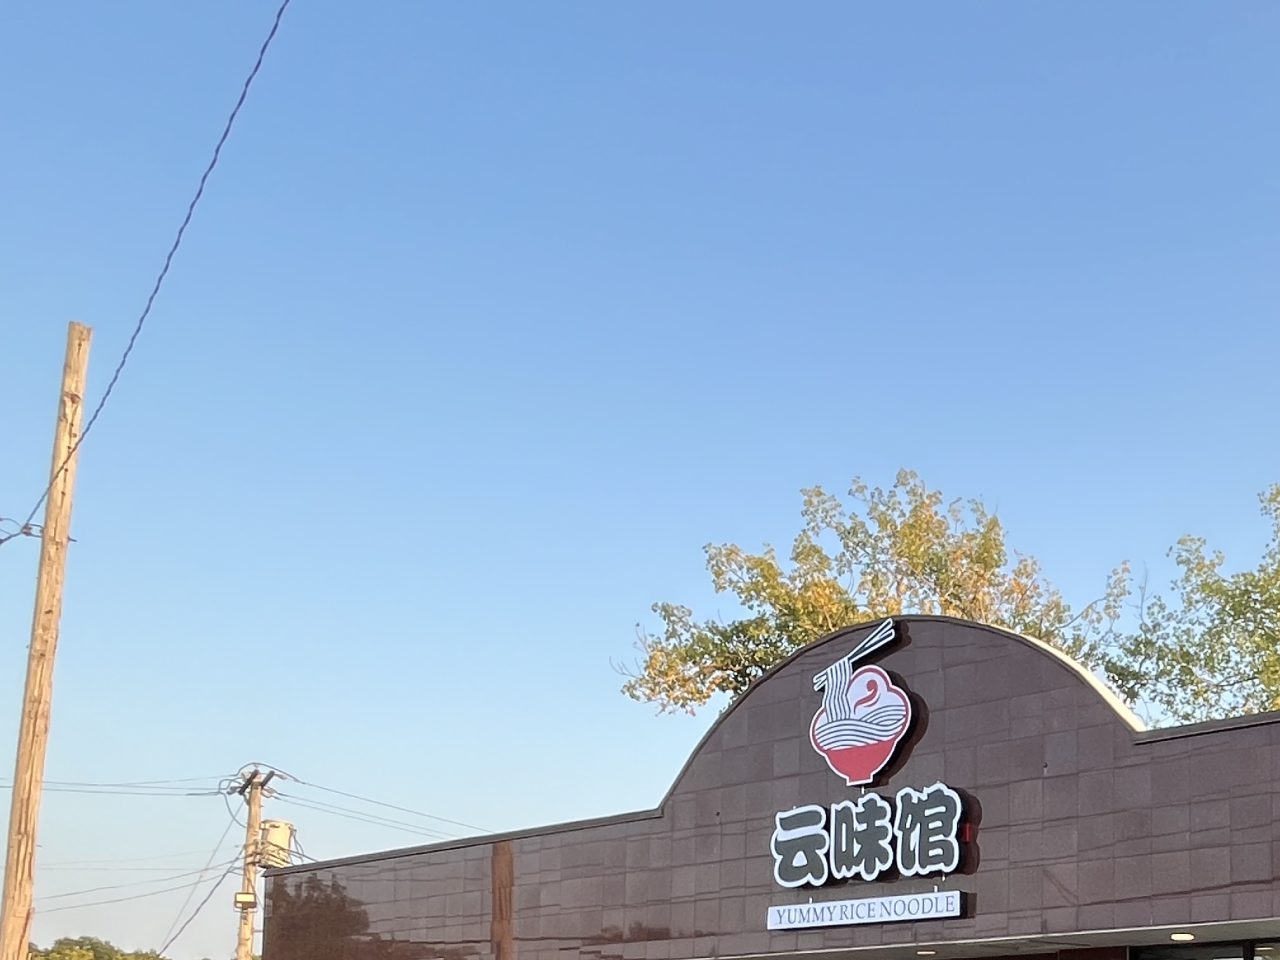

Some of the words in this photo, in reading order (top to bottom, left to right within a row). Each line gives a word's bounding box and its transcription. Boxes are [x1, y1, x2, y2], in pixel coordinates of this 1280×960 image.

[770, 783, 962, 888] 云味馆
[776, 904, 837, 925] YUMMY
[839, 902, 876, 921] RICE
[879, 895, 956, 918] NOODLE
